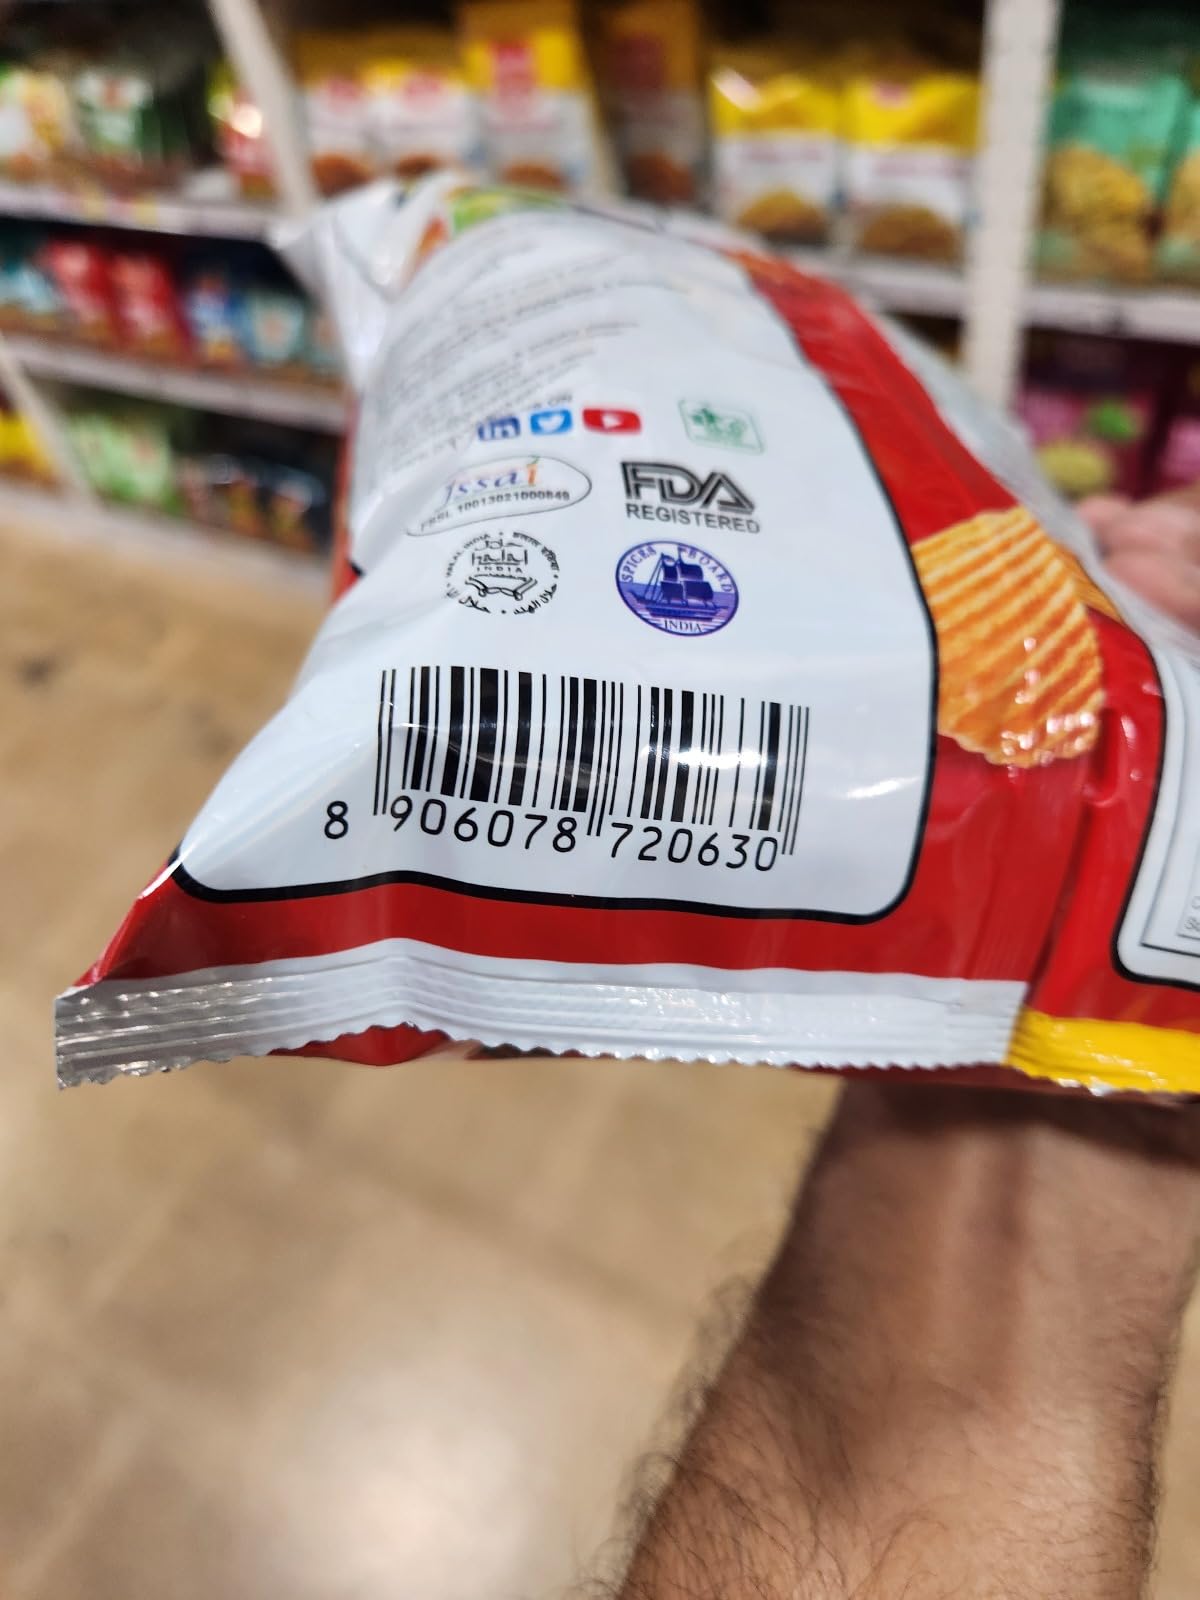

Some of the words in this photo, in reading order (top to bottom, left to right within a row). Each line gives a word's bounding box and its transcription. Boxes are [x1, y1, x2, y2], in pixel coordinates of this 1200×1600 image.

[620, 461, 755, 515] FDA
[625, 502, 760, 535] REGISTERED
[687, 548, 733, 593] BOARD
[664, 619, 703, 633] INDIA
[323, 800, 349, 840] 8
[389, 795, 577, 854] 906078
[609, 823, 779, 872] 720630
